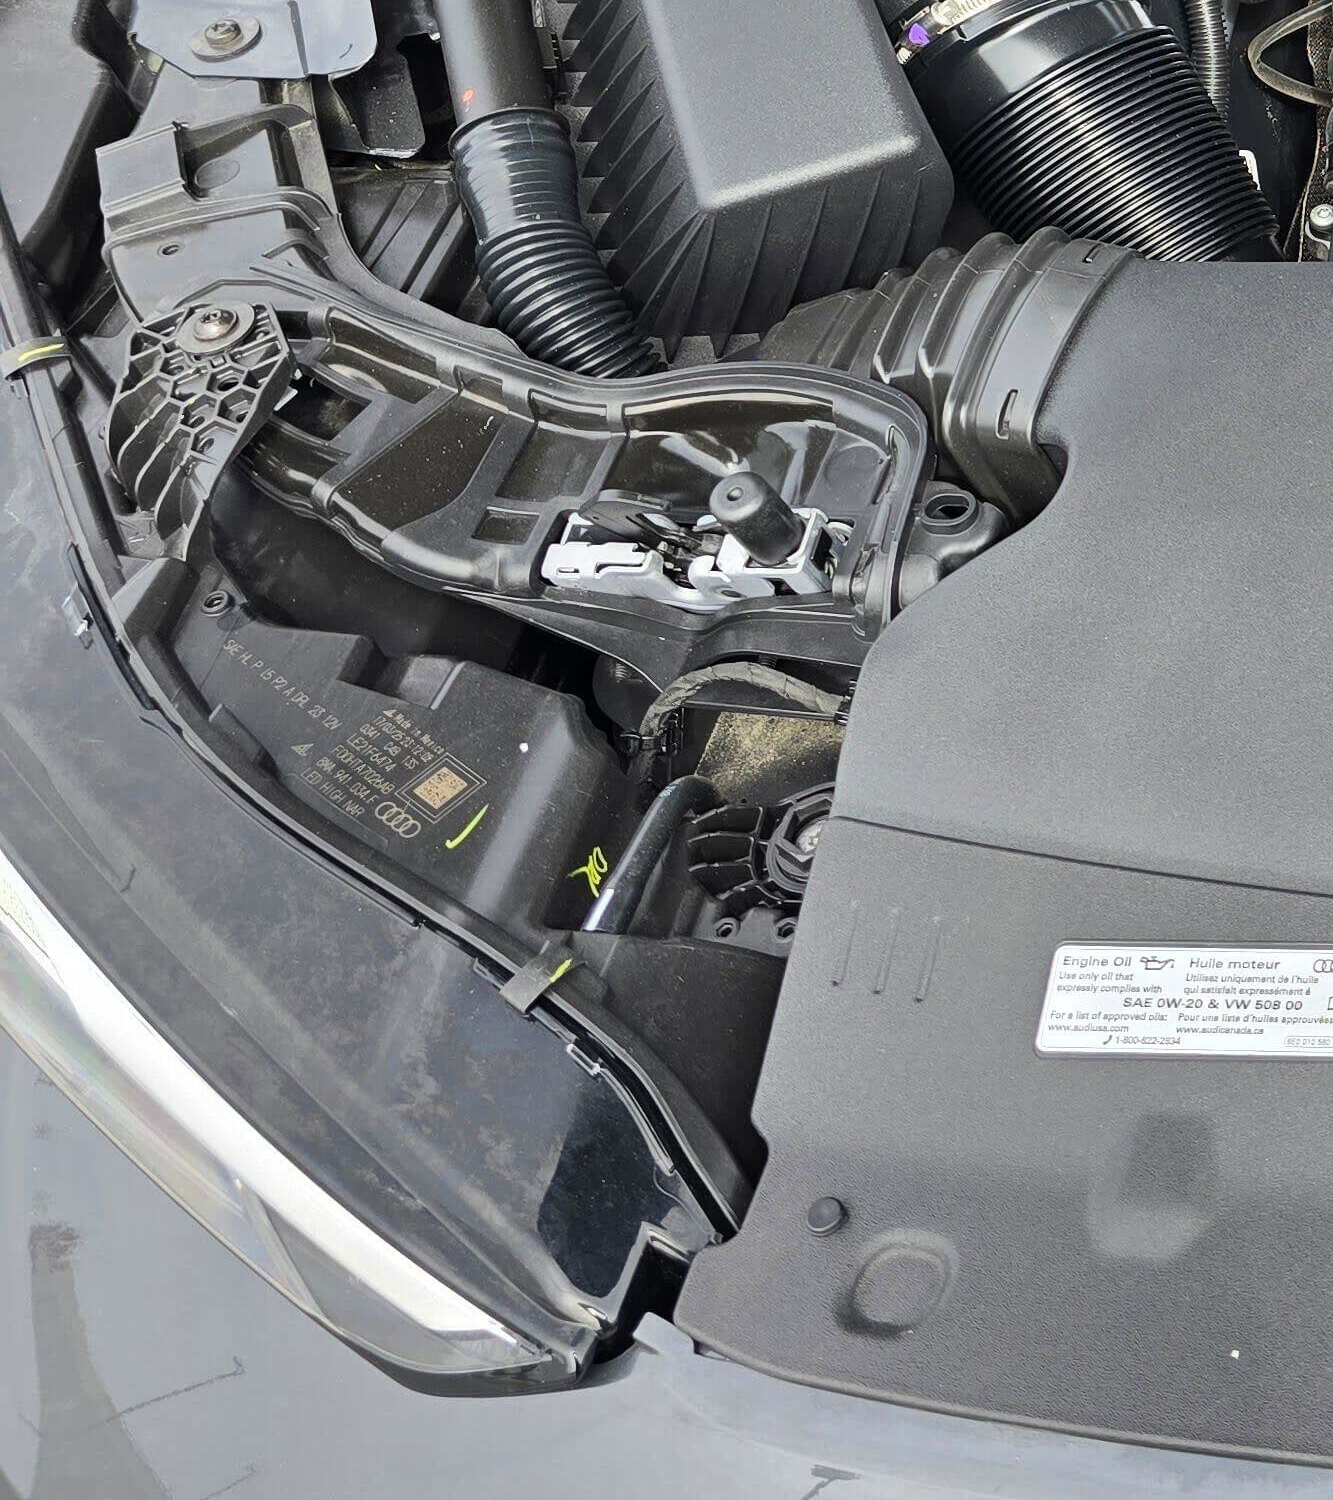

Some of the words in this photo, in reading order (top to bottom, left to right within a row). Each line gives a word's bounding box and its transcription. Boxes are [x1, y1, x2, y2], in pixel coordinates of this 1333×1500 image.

[1062, 956, 1109, 968] Engine
[1113, 956, 1132, 967] Oil
[1189, 958, 1223, 969] Huile
[1228, 959, 1281, 970] moteur
[1059, 972, 1077, 980] Use
[1078, 973, 1099, 981] only
[1101, 972, 1113, 980] oil
[1115, 973, 1134, 981] that
[1186, 973, 1218, 982] Utilisez
[1221, 974, 1276, 985] uniquement
[1277, 975, 1289, 984] de
[1056, 984, 1099, 994] expressly
[1100, 985, 1141, 994] complies
[1143, 985, 1163, 994] with
[1184, 986, 1199, 995] qui
[1201, 986, 1237, 995] satisfait
[1238, 987, 1303, 996] expressément
[1123, 997, 1152, 1008] SAE
[1157, 998, 1203, 1009] 0W-20
[1207, 999, 1219, 1009] &
[1225, 999, 1251, 1010] VW
[1255, 1000, 1281, 1010] 508
[1285, 1000, 1303, 1010] 00
[1050, 1010, 1064, 1019] For
[1075, 1011, 1089, 1020] list
[1091, 1011, 1101, 1020] of
[1103, 1012, 1146, 1022] approved
[1178, 1012, 1200, 1022] Pour
[1221, 1014, 1240, 1023] liste
[1048, 1023, 1129, 1033] www.audiusa.com
[1176, 1026, 1264, 1035] www.audicanada.ca
